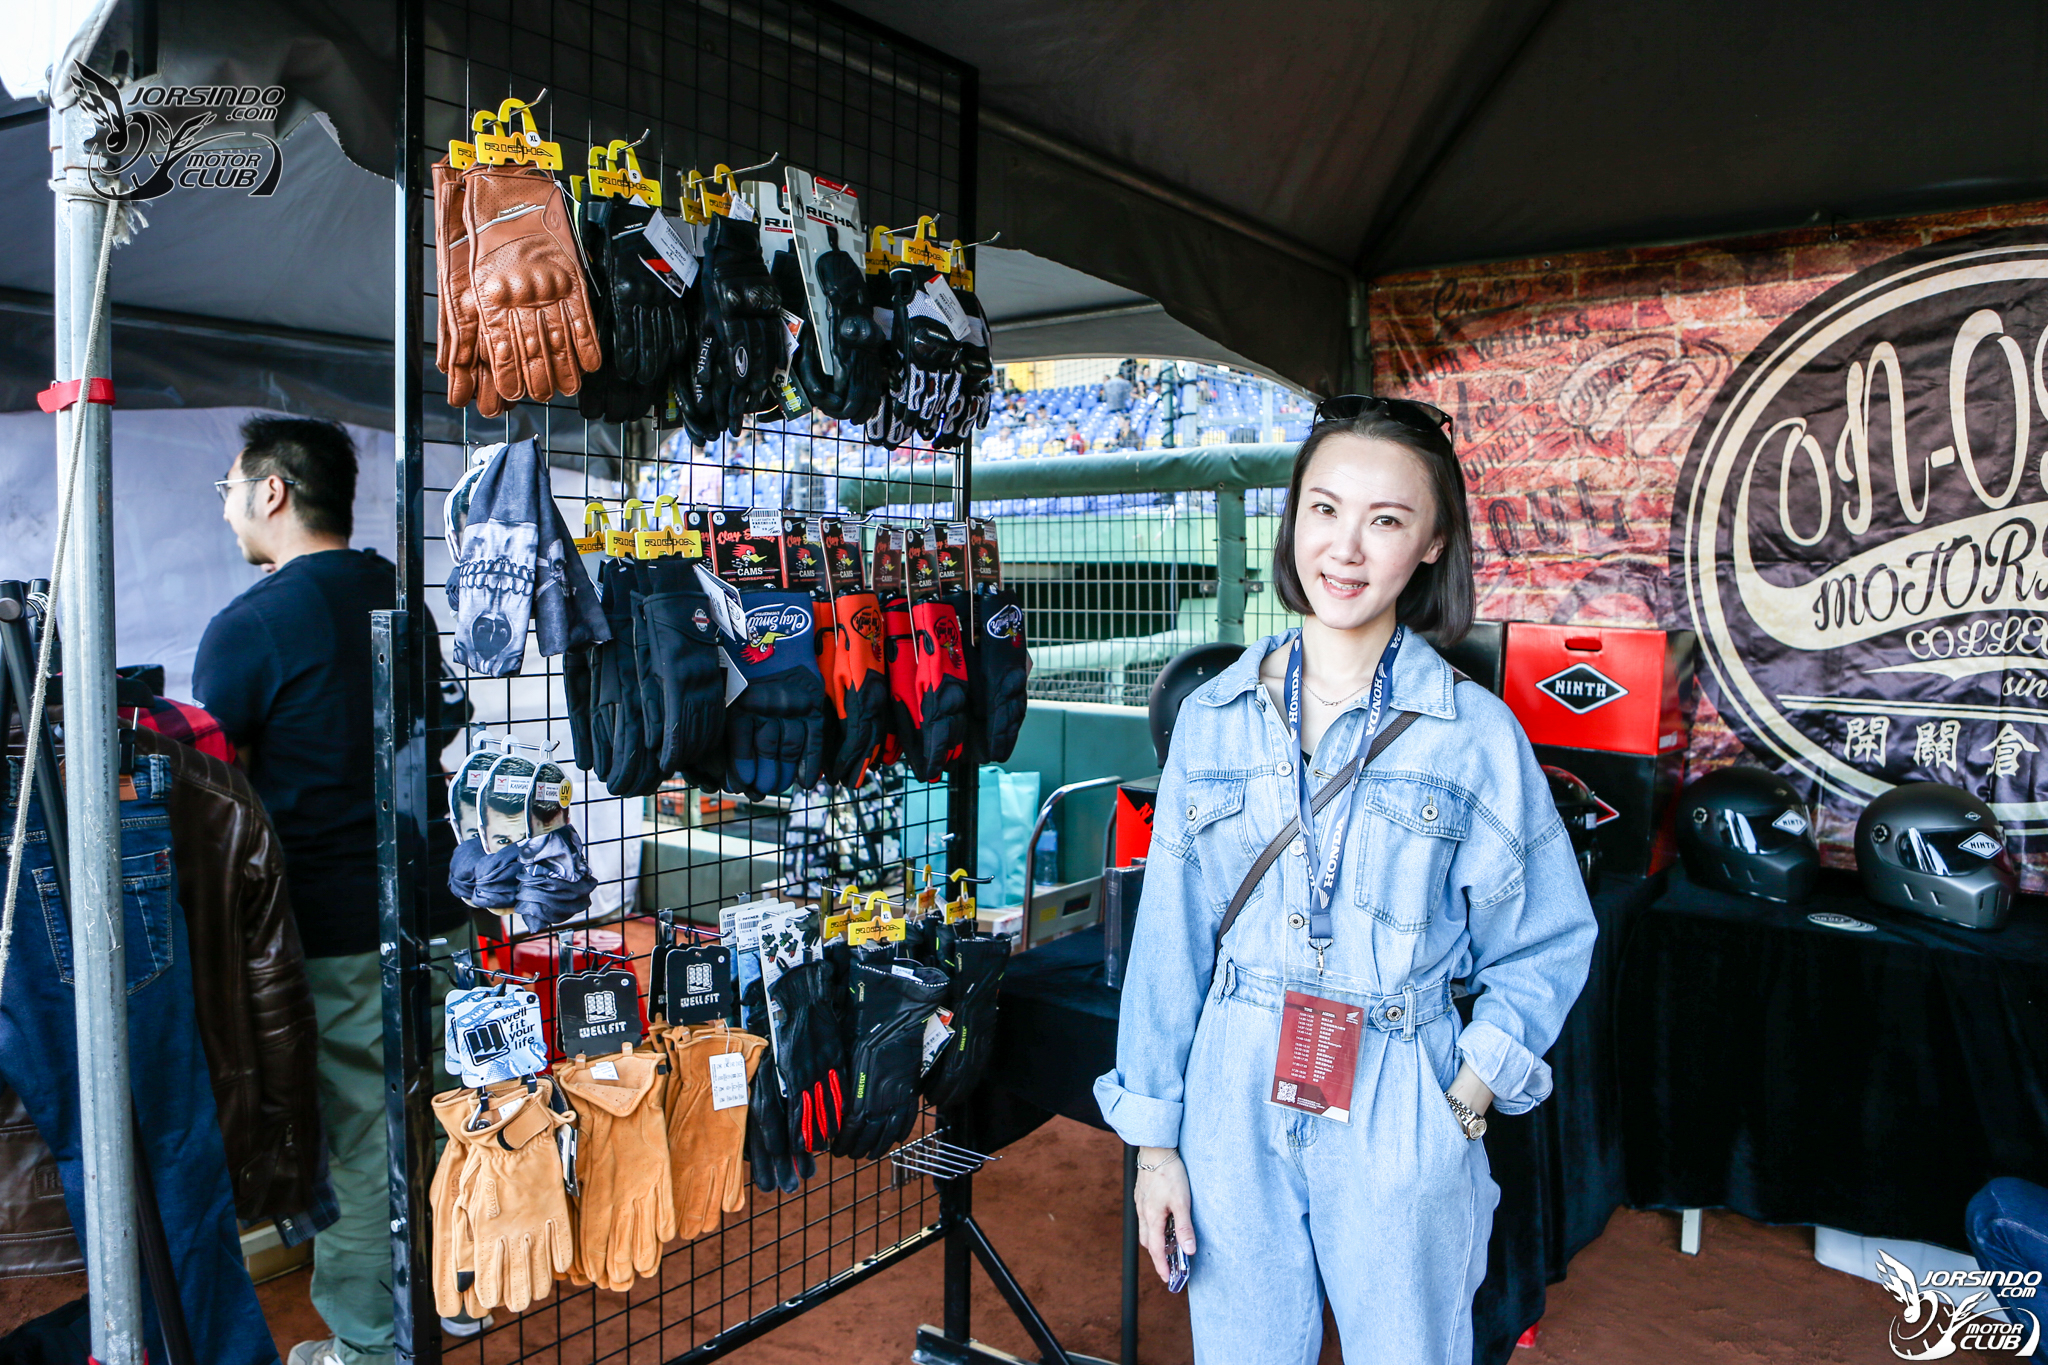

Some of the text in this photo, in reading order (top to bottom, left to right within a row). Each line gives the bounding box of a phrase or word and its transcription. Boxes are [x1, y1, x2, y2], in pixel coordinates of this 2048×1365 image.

[484, 142, 554, 158] RICHA
[597, 175, 655, 193] RICHA
[805, 205, 858, 231] RICHA
[908, 245, 946, 263] RICHA
[1471, 312, 1592, 364] WHEELS
[613, 536, 636, 548] RIC
[644, 537, 696, 547] RICHA
[716, 530, 742, 545] Clay
[737, 567, 763, 577] CAMS
[799, 570, 815, 578] CAMS
[840, 570, 854, 578] CAMS
[940, 570, 956, 578] CAMS
[1812, 517, 2048, 632] MOTOR
[1288, 664, 1300, 724] HONDA
[1554, 679, 1607, 698] NINTH
[1365, 675, 1384, 737] HONDA
[561, 785, 570, 795] UV
[1323, 815, 1346, 889] HONDA
[1970, 841, 1996, 850] NINTH
[855, 923, 901, 935] RICHA
[680, 992, 721, 1008] WELL FIT
[508, 1023, 536, 1042] your
[509, 1018, 526, 1032] fit
[578, 1021, 627, 1039] WELL FIT
[514, 1034, 535, 1050] life
